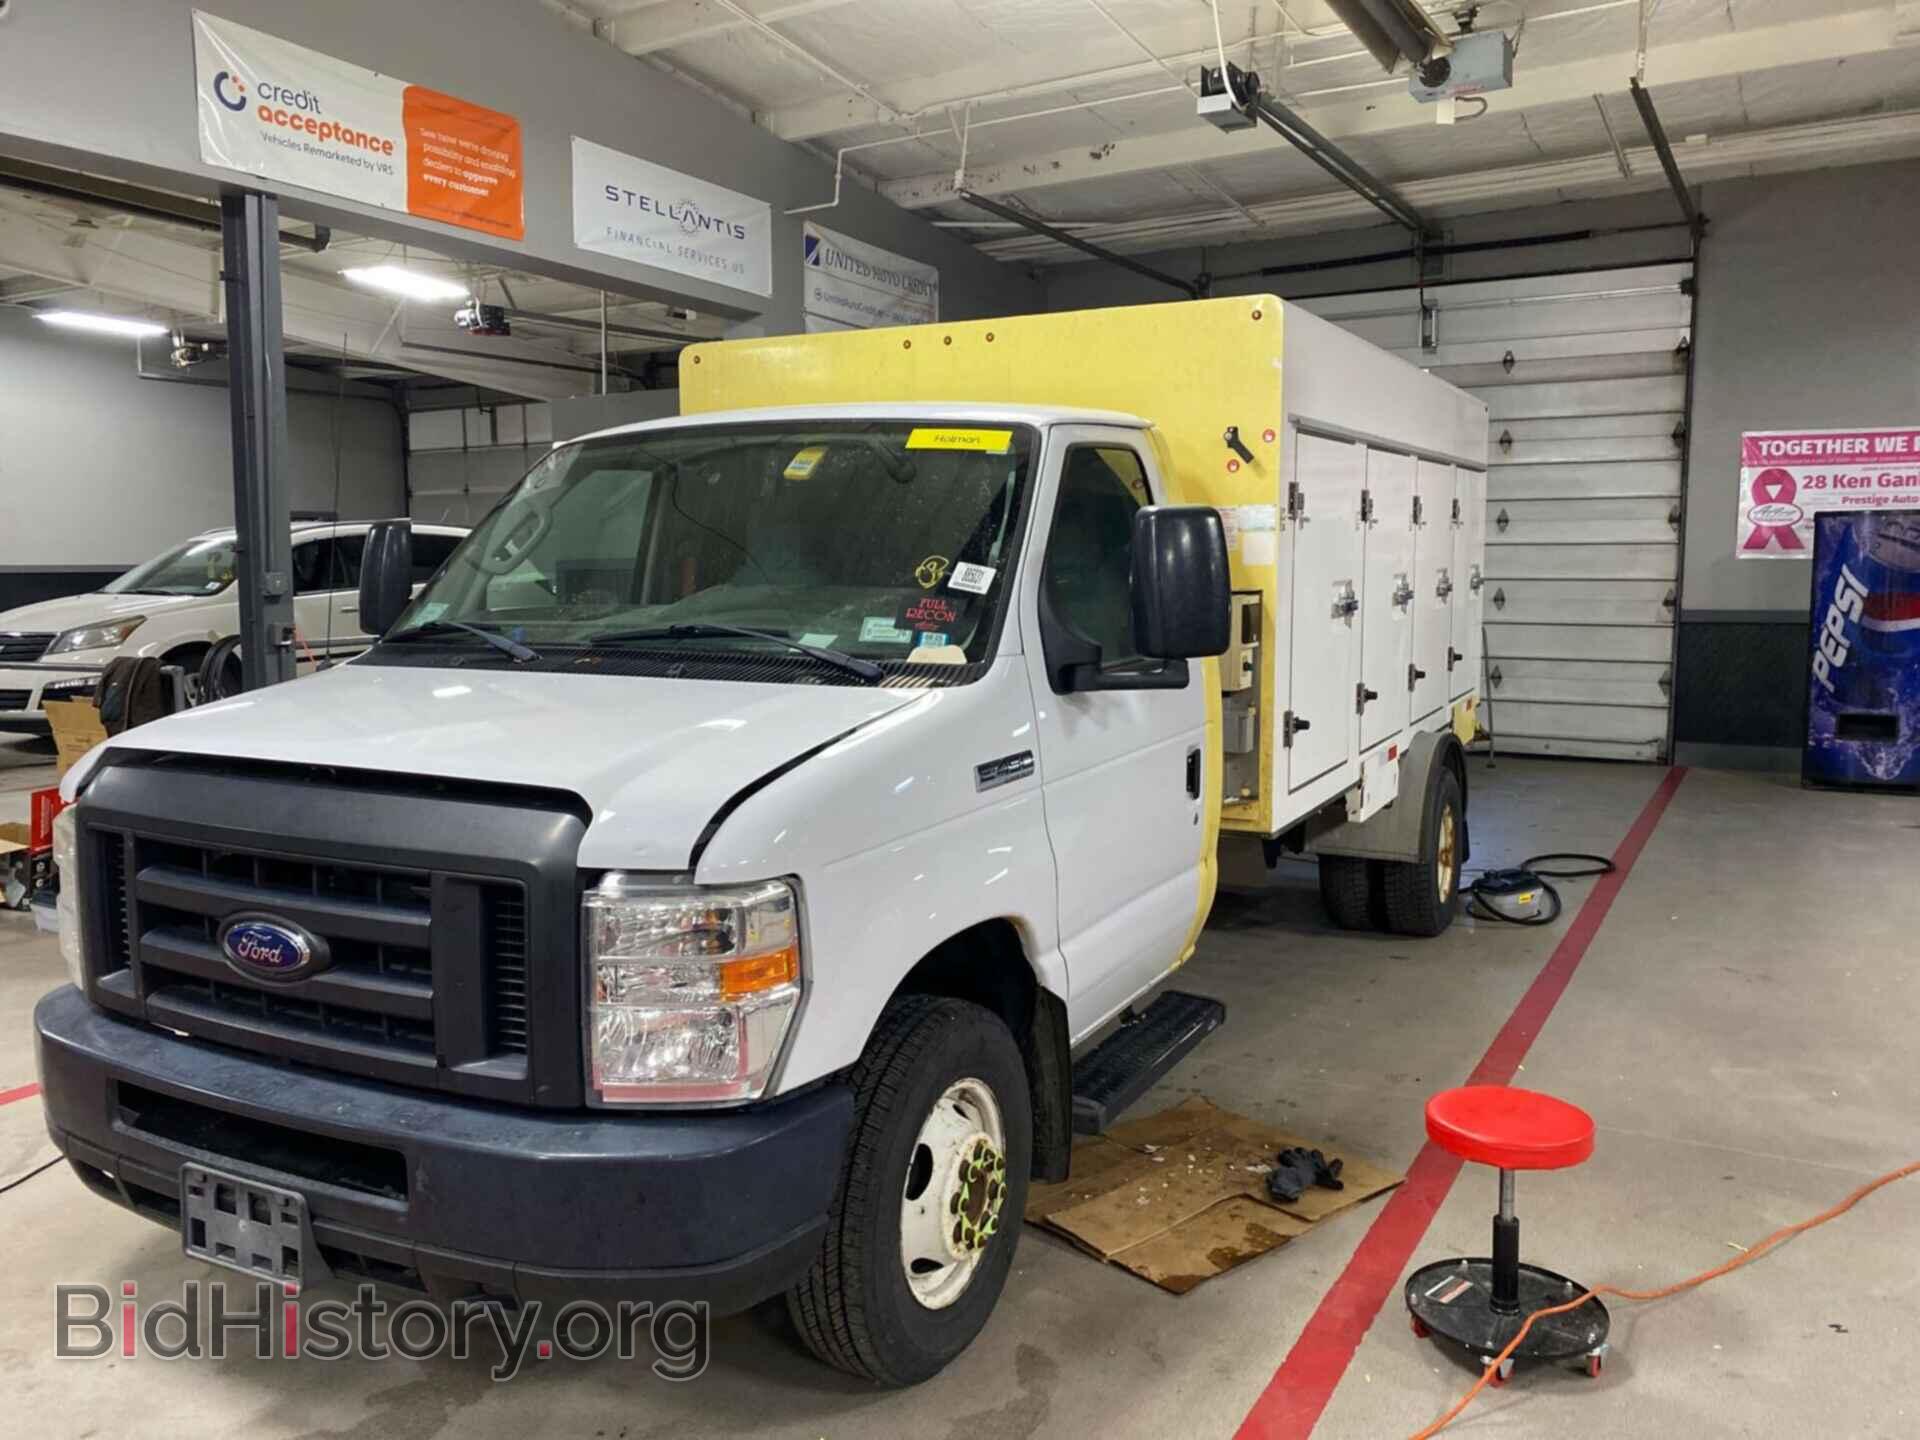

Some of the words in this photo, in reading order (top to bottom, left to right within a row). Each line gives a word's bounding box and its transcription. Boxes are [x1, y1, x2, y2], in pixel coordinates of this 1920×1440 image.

[257, 82, 322, 114] credit
[257, 104, 394, 156] acceptance
[260, 130, 301, 152] Vehicles
[303, 142, 362, 167] Remarketed
[363, 159, 375, 171] by
[605, 185, 745, 240] STELLANTIS
[606, 226, 672, 254] FINANCIAL
[677, 246, 728, 271] SERVICES
[731, 262, 745, 275] US
[825, 247, 871, 278] UNITED
[1758, 439, 1869, 456] TOGETHER
[1874, 436, 1909, 453] WE
[1802, 474, 1827, 489] 28
[1833, 474, 1872, 489] Ken
[1841, 495, 1890, 506] Prestige
[1892, 495, 1920, 504] Auto
[905, 607, 956, 622] RECON
[919, 598, 946, 611] FULL
[1812, 563, 1869, 693] PEPSI
[237, 930, 284, 963] Ford
